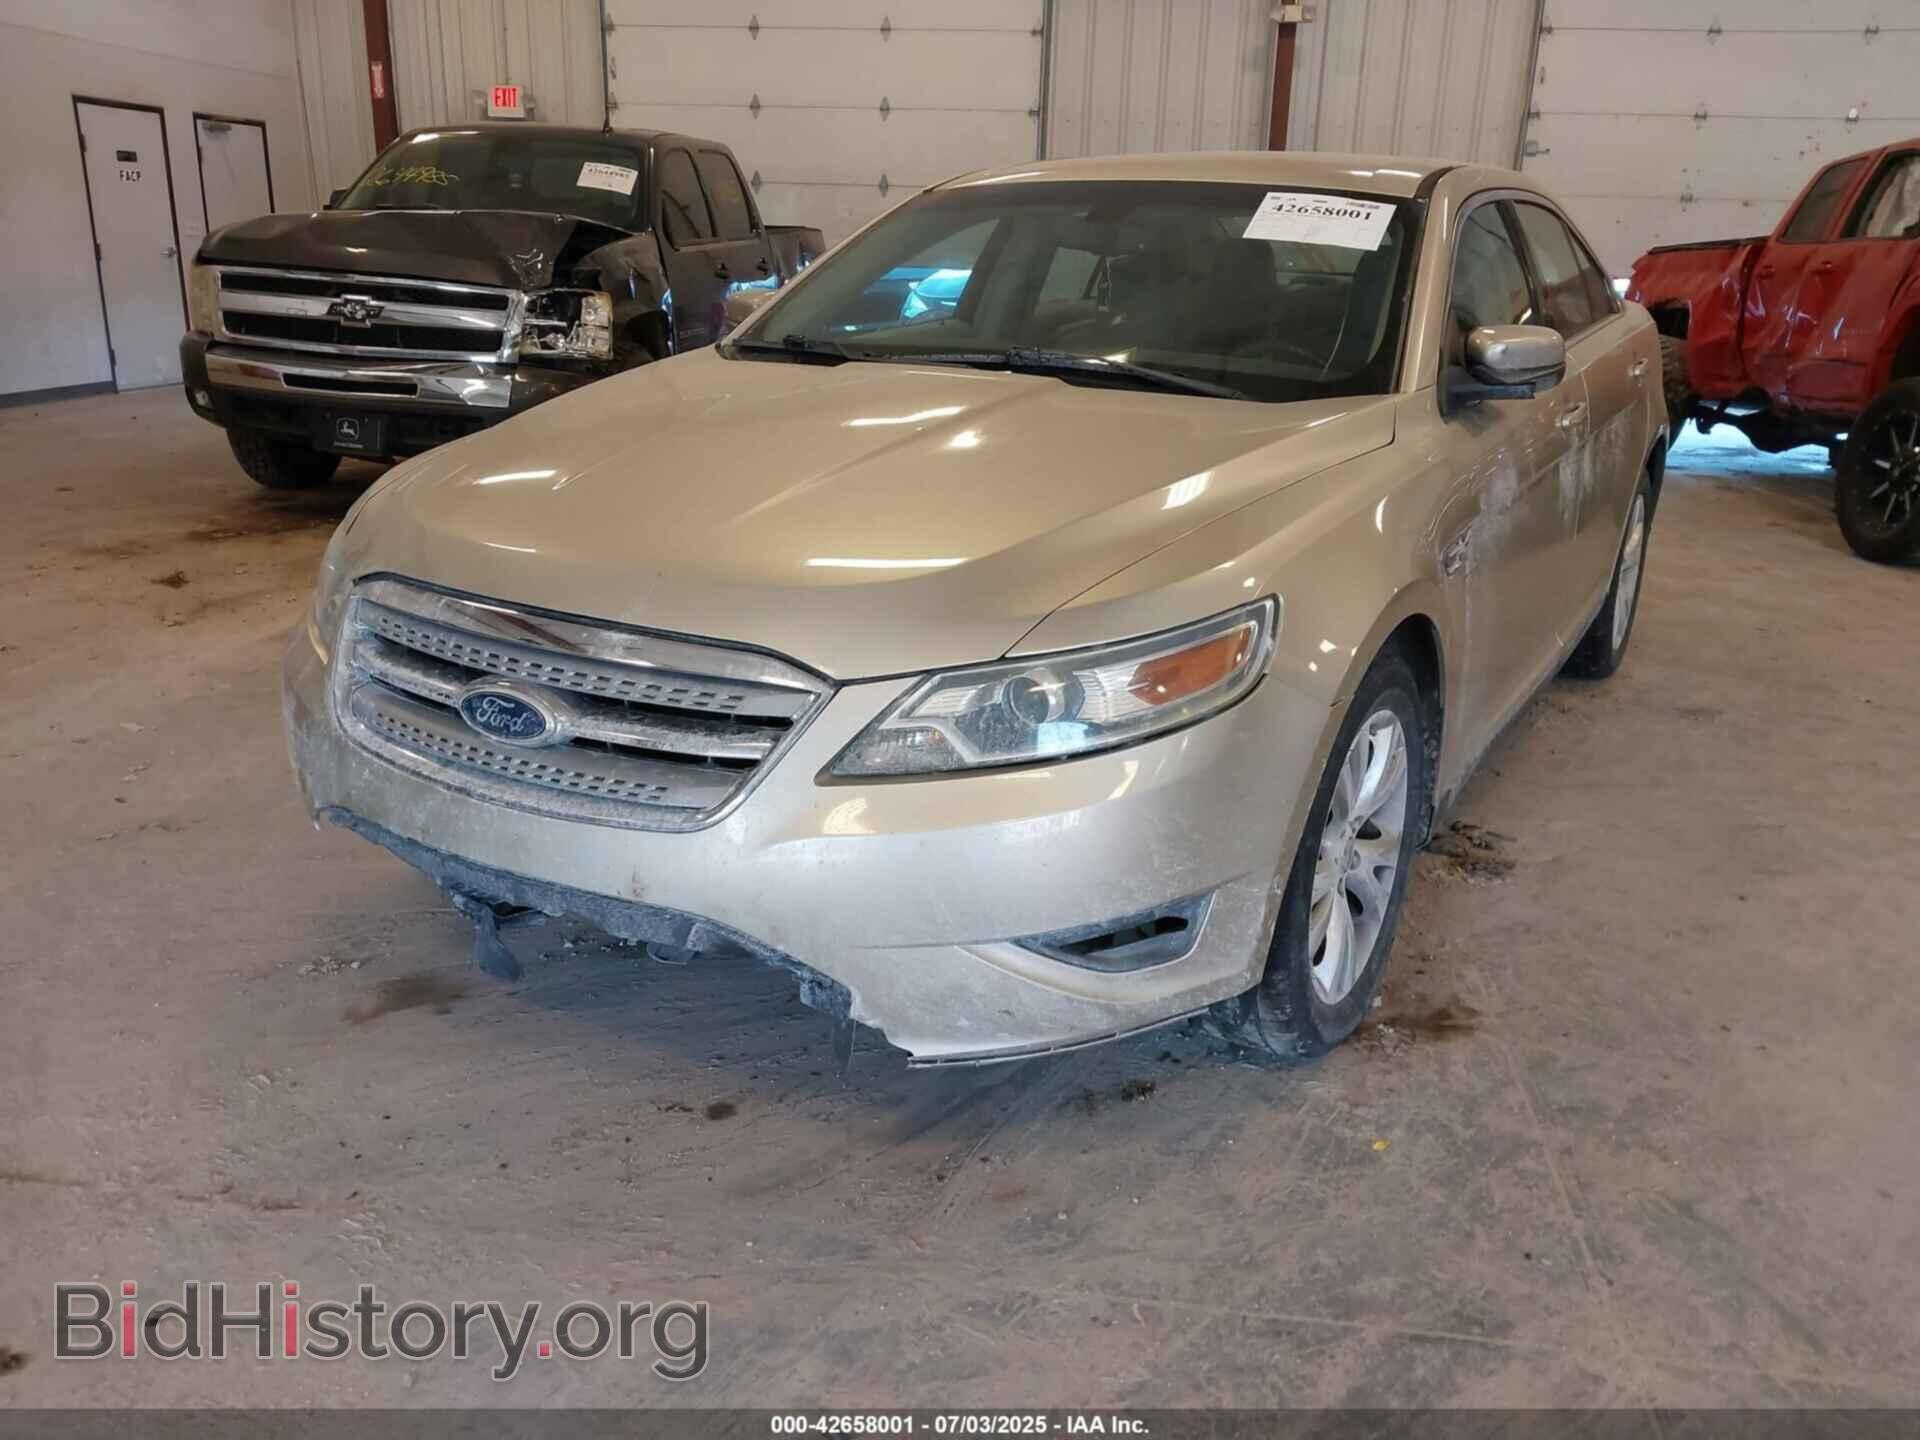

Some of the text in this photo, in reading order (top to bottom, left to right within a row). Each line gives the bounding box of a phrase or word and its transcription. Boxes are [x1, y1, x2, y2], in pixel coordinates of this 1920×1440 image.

[495, 87, 517, 107] EXIT
[1272, 203, 1371, 220] 42658001
[476, 696, 528, 732] Ford
